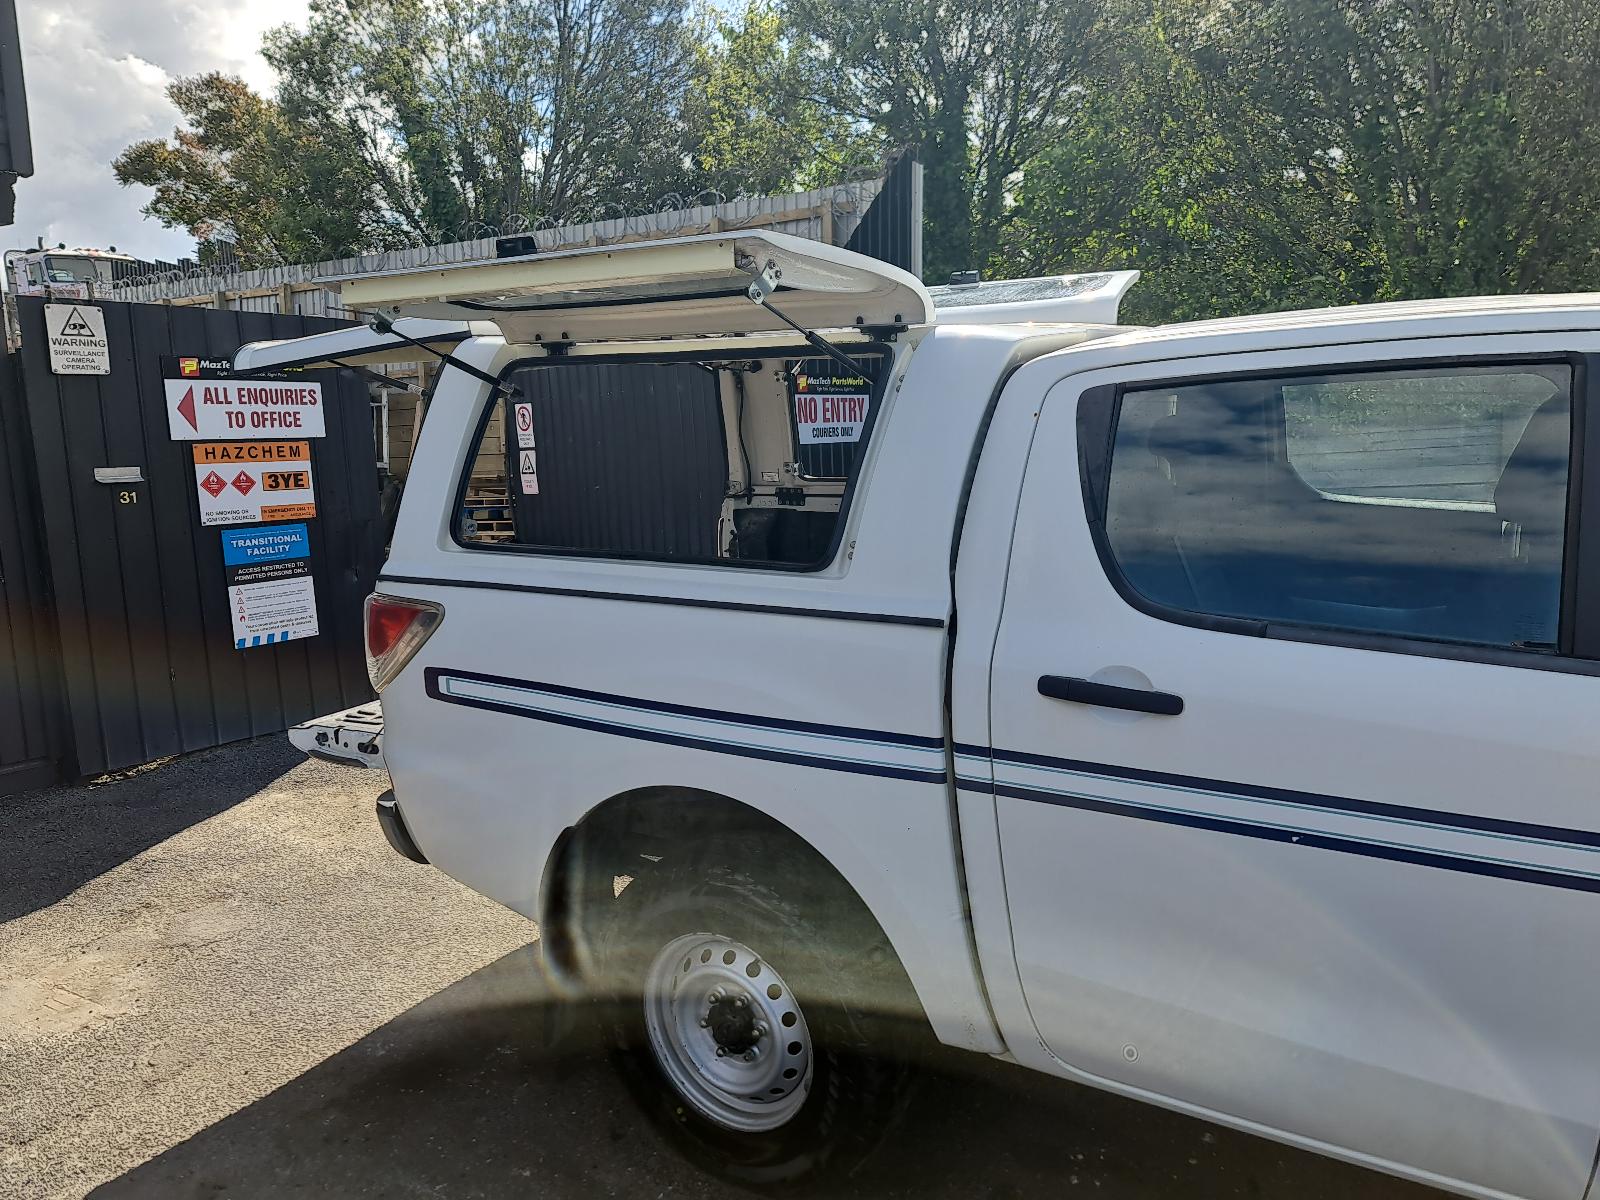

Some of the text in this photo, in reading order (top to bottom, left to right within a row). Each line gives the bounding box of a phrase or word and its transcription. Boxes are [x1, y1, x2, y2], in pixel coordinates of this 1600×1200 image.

[51, 337, 106, 348] WARNING
[53, 349, 106, 357] SURVEILLANCE
[831, 376, 864, 386] PartsWorld
[203, 386, 318, 407] ALL ENQUIRIES
[797, 396, 865, 424] NO ENTRY
[225, 410, 303, 429] TO OFFICE
[812, 426, 854, 438] COURIERS ONLY
[204, 445, 301, 460] HAZCHEM
[267, 473, 305, 489] 3YE
[119, 491, 137, 504] 31
[230, 534, 303, 548] TRANSITIONAL
[246, 544, 290, 556] FACILITY
[238, 566, 261, 575] ACCESS
[261, 562, 295, 572] RESTRICTED
[234, 572, 266, 582] PERMITTED
[266, 569, 293, 578] PERSONS
